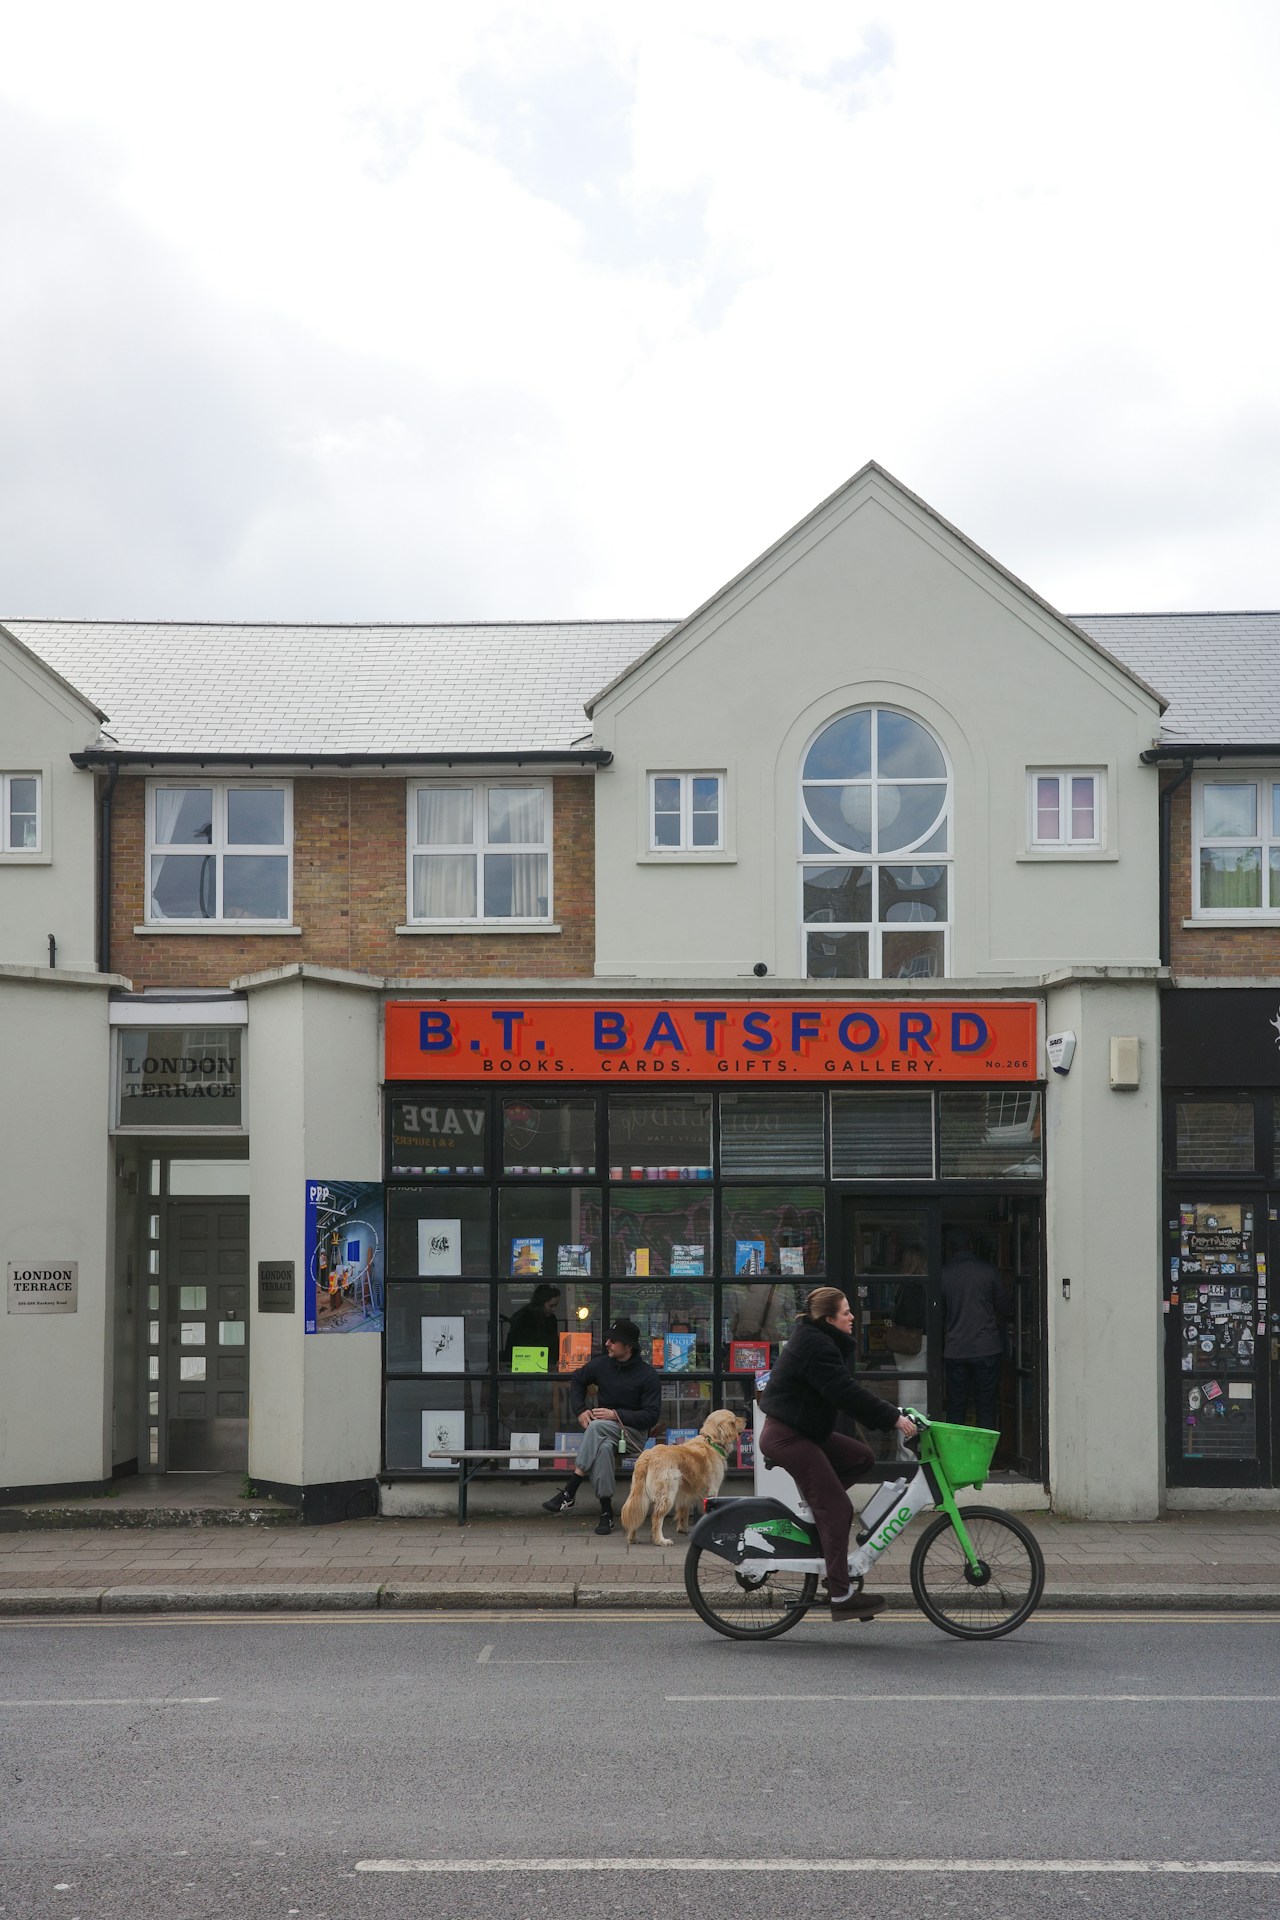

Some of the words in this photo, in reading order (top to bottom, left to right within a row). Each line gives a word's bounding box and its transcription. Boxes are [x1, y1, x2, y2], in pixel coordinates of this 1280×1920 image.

[419, 1011, 546, 1052] B.T.
[594, 1011, 989, 1053] BATSFORD
[125, 1057, 237, 1074] LONDON
[483, 1060, 575, 1072] BOOKS.
[601, 1060, 691, 1072] CARDS.
[717, 1060, 798, 1072] GIFTS.
[824, 1060, 943, 1072] GALLERY.
[985, 1060, 1028, 1068] No.266
[126, 1083, 236, 1098] TERRACE
[13, 1270, 72, 1281] LONDON
[260, 1270, 292, 1280] LONDON
[14, 1282, 72, 1291] TERRACE
[261, 1282, 292, 1291] TERRACE
[869, 1507, 913, 1551] Lime
